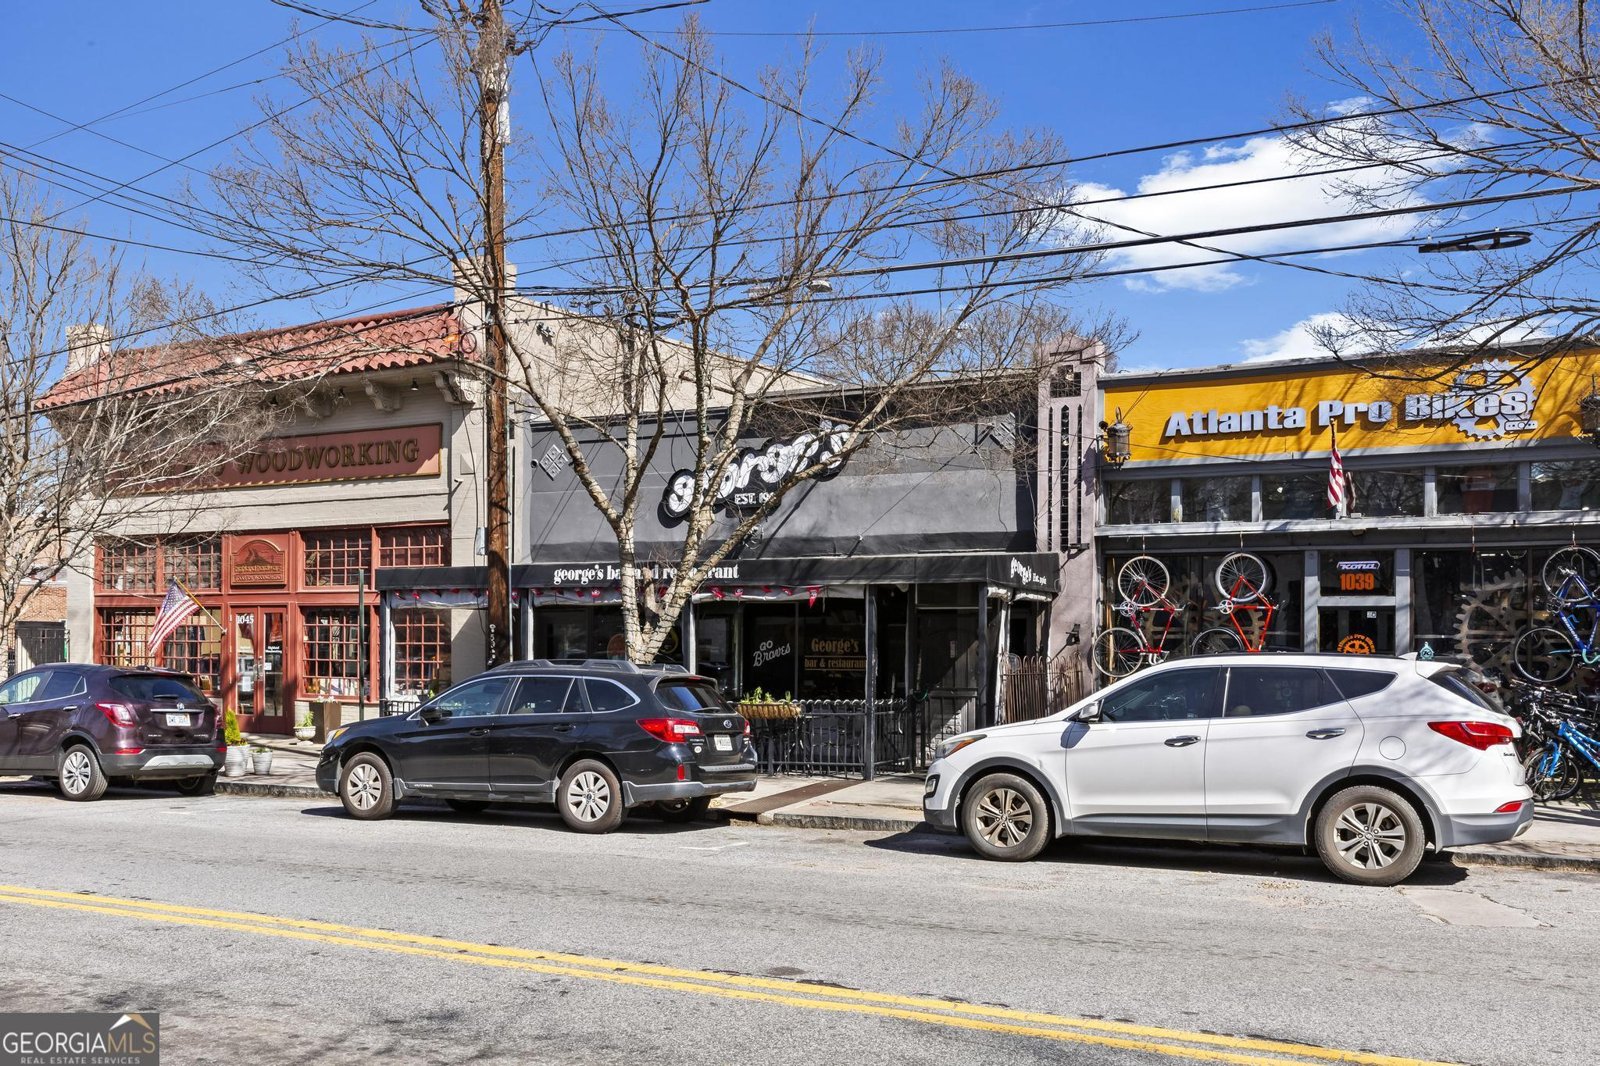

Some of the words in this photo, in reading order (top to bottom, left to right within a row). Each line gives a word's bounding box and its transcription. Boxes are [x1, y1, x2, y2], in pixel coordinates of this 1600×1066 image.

[1165, 405, 1307, 437] Atlanta
[1319, 400, 1392, 426] Pro
[237, 438, 420, 475] WOODWORKING
[734, 492, 757, 505] EST.
[553, 564, 604, 585] george's
[634, 564, 660, 579] ad
[1340, 573, 1375, 590] 1039
[236, 614, 254, 624] 1045
[760, 640, 774, 651] GO
[811, 638, 860, 655] George's
[753, 643, 791, 667] Braves
[804, 657, 818, 668] bar
[828, 656, 867, 668] restauran
